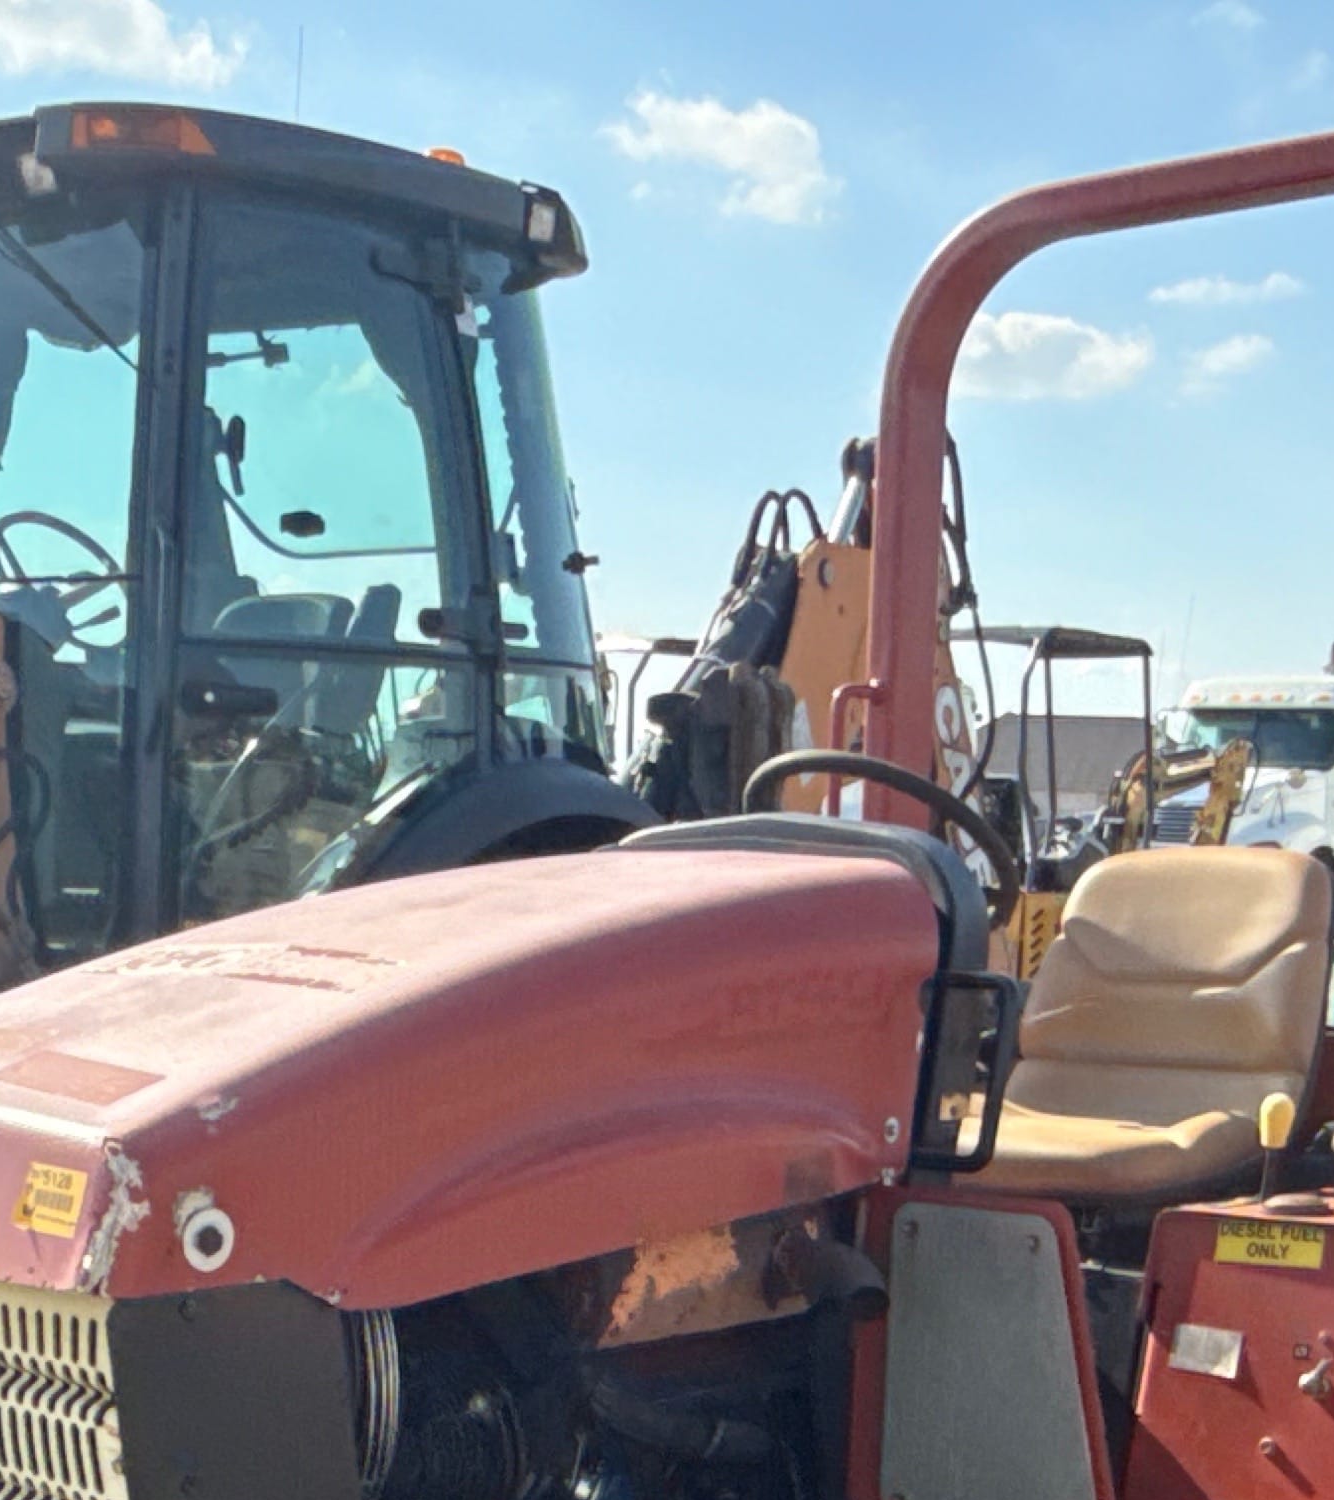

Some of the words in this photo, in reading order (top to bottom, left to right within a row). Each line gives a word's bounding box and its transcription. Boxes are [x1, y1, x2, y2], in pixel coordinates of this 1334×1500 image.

[1221, 1221, 1276, 1240] DIESEL
[1280, 1222, 1323, 1243] FUEL
[1246, 1241, 1290, 1260] ONLY
